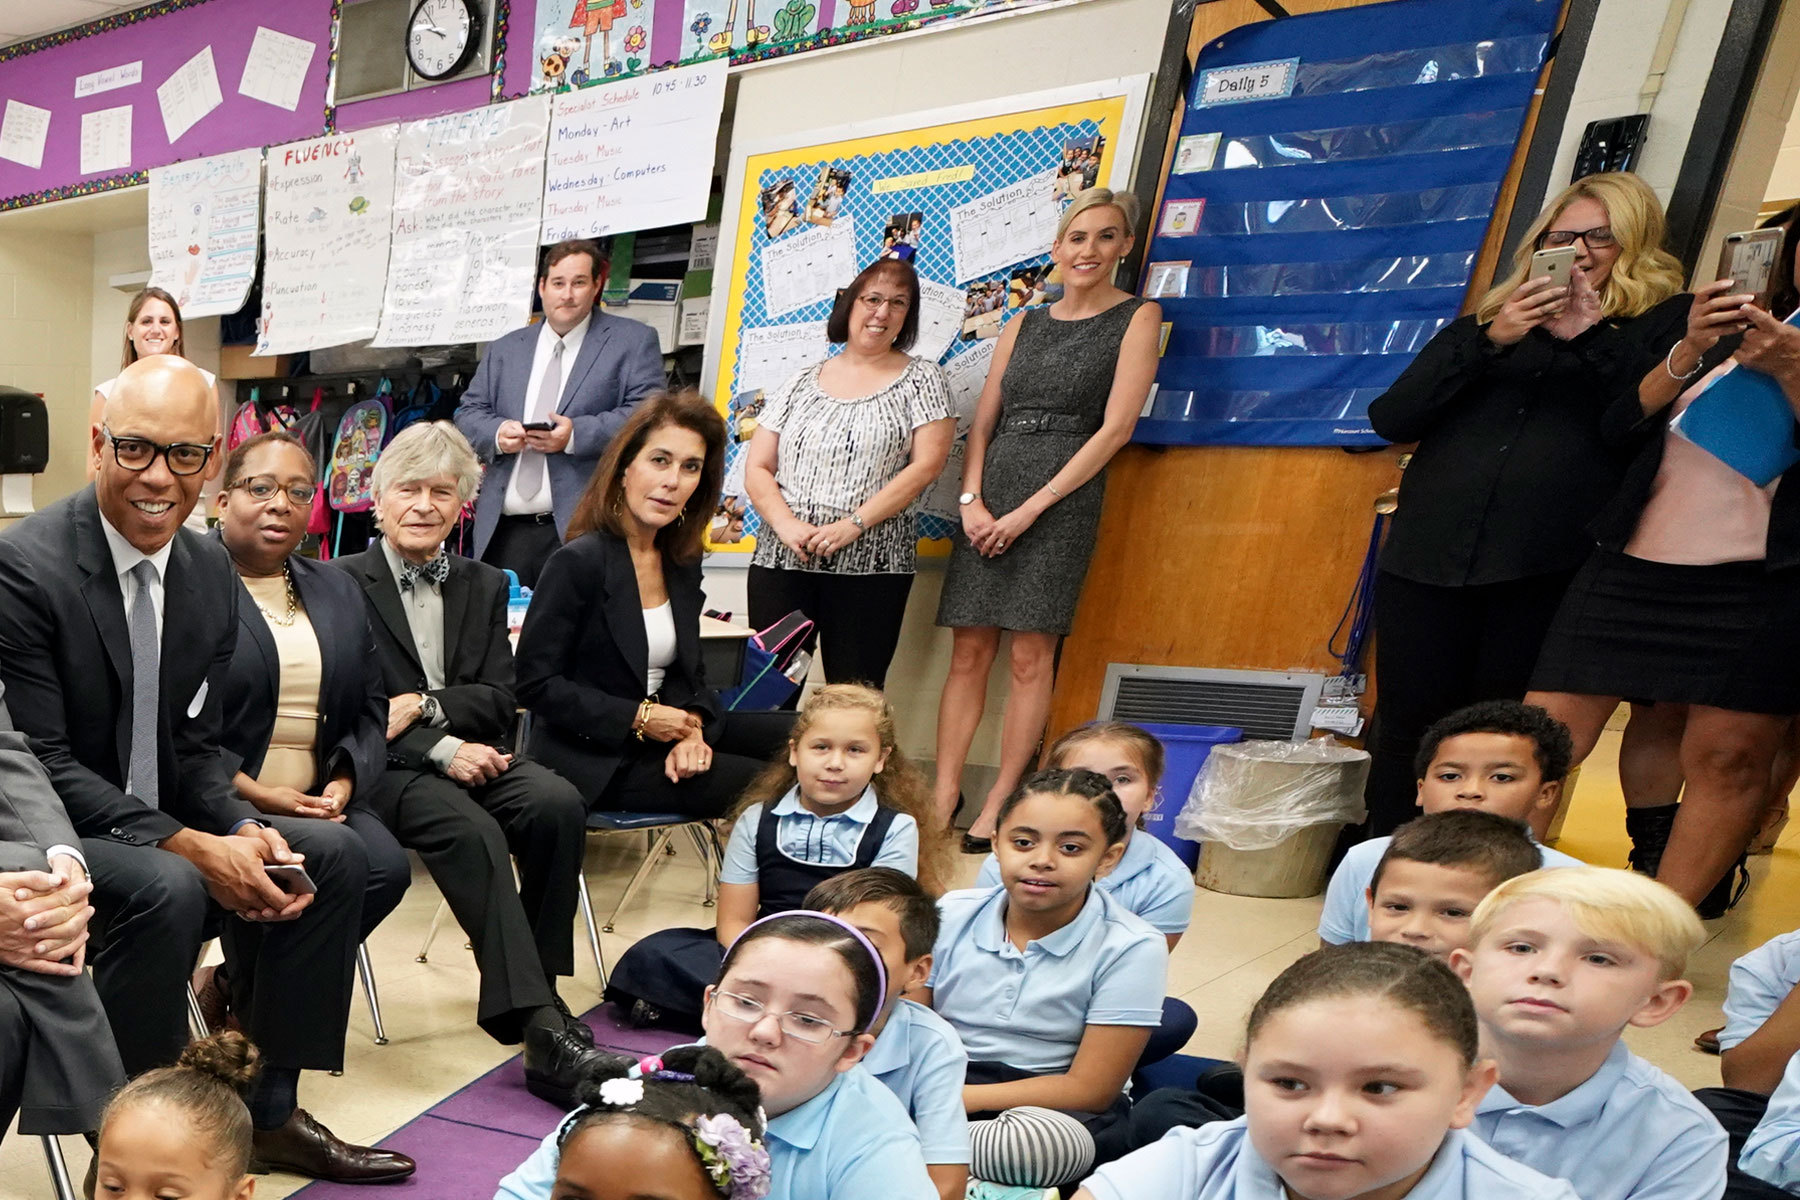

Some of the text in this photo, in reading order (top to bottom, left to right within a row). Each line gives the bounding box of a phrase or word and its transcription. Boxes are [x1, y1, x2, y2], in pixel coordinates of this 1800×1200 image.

[459, 8, 465, 19] 2
[415, 34, 421, 45] 9
[418, 49, 424, 60] 8
[426, 57, 431, 67] 7
[448, 53, 454, 64] 5
[437, 59, 443, 70] 6
[1219, 75, 1270, 93] Daily 5
[556, 88, 640, 117] Specialist Schedule
[558, 116, 631, 141] Monday Art
[284, 138, 355, 166] FLUENCY
[551, 145, 623, 166] Tuesday Music
[206, 155, 245, 180] Details
[273, 174, 323, 192] Expression
[548, 163, 667, 193] Wednesday Computers
[547, 195, 622, 216] Thursday Music
[956, 187, 1023, 220] The Solution
[275, 210, 300, 225] Rate
[546, 221, 610, 241] Friday Gym
[272, 247, 316, 262] Accuracy
[767, 232, 822, 260] The Solution
[749, 329, 802, 342] The Solution
[954, 342, 994, 371] Solution
